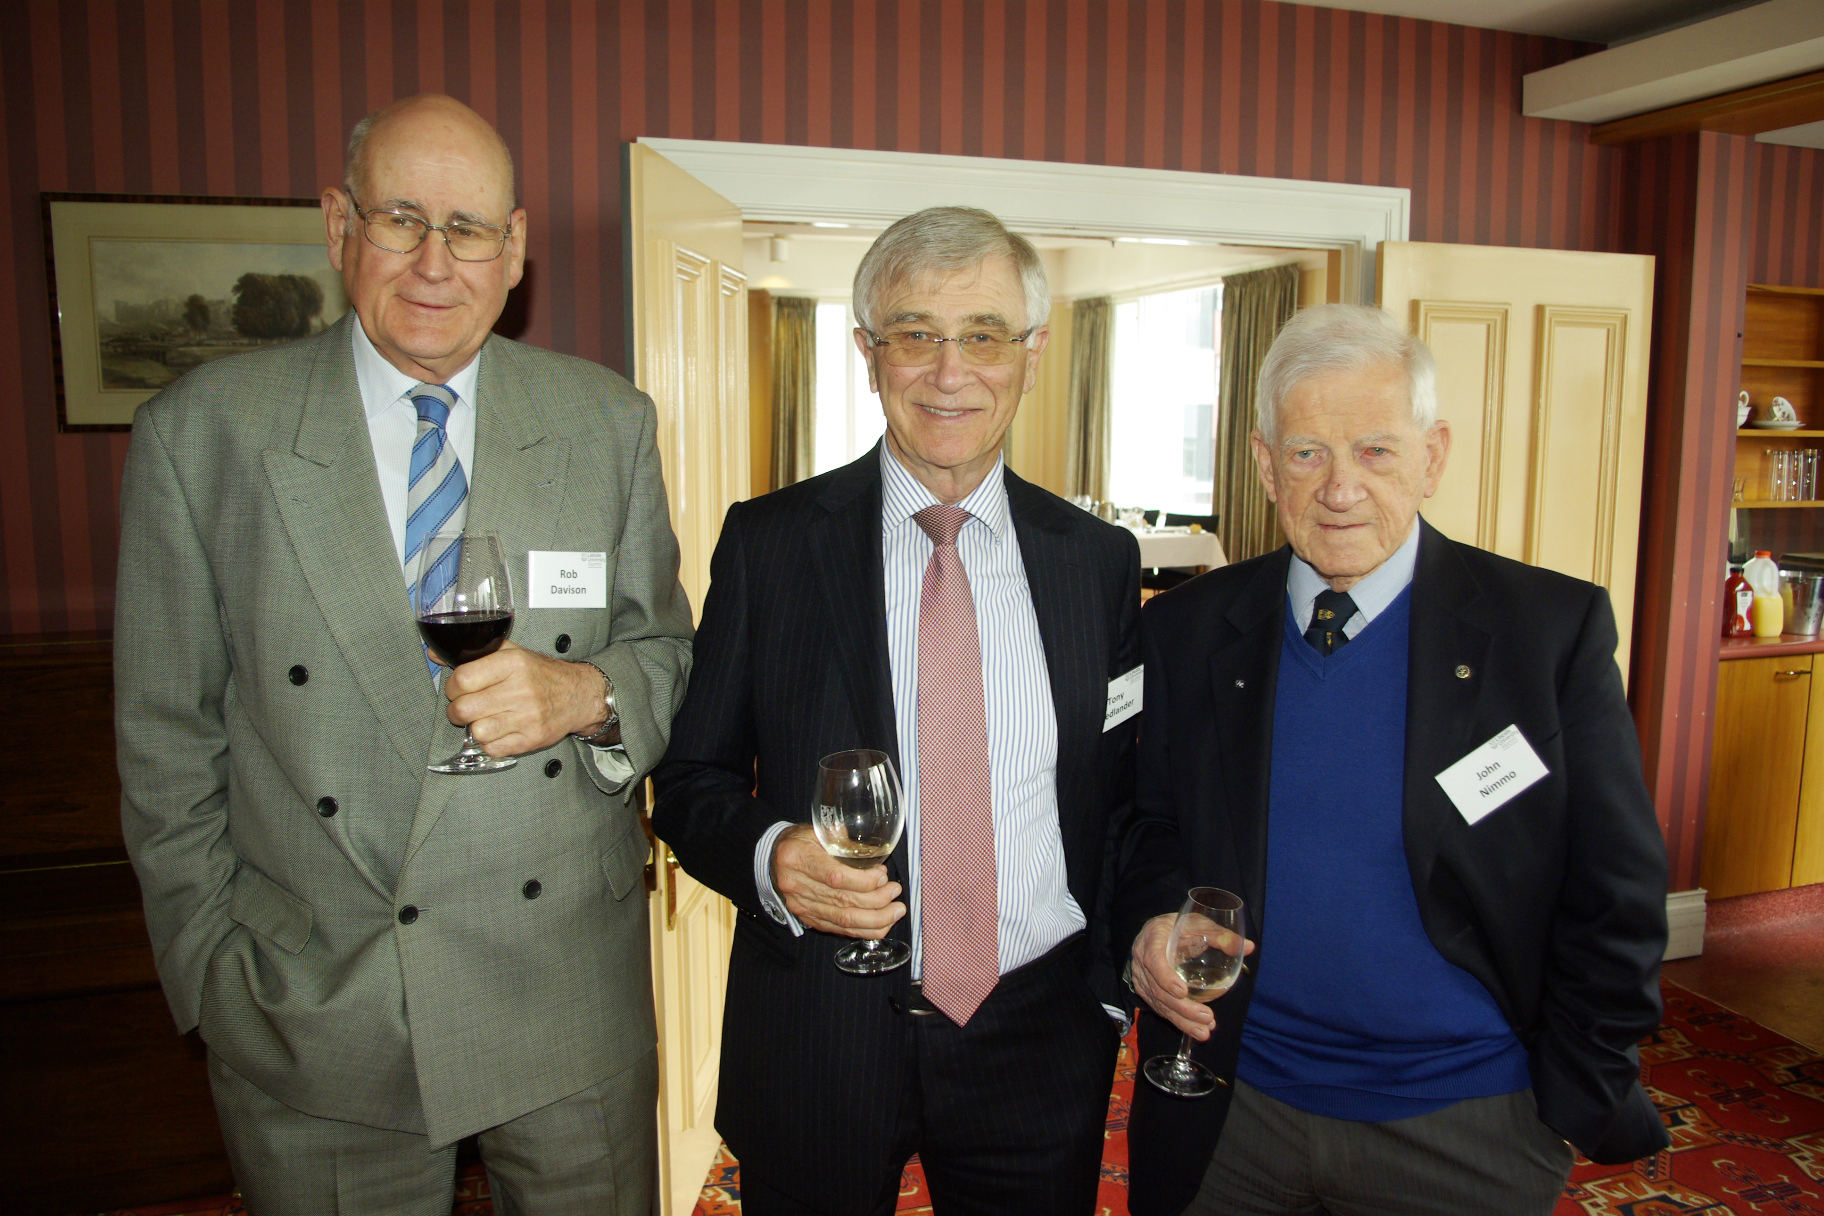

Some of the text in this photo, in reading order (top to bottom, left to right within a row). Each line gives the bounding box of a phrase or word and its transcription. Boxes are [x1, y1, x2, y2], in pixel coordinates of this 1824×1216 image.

[560, 570, 578, 578] Rob
[550, 585, 586, 594] Davison
[1106, 692, 1124, 706] Tony
[1106, 699, 1134, 720] edlander
[1476, 761, 1501, 781] John
[1478, 770, 1517, 798] Nimmo
